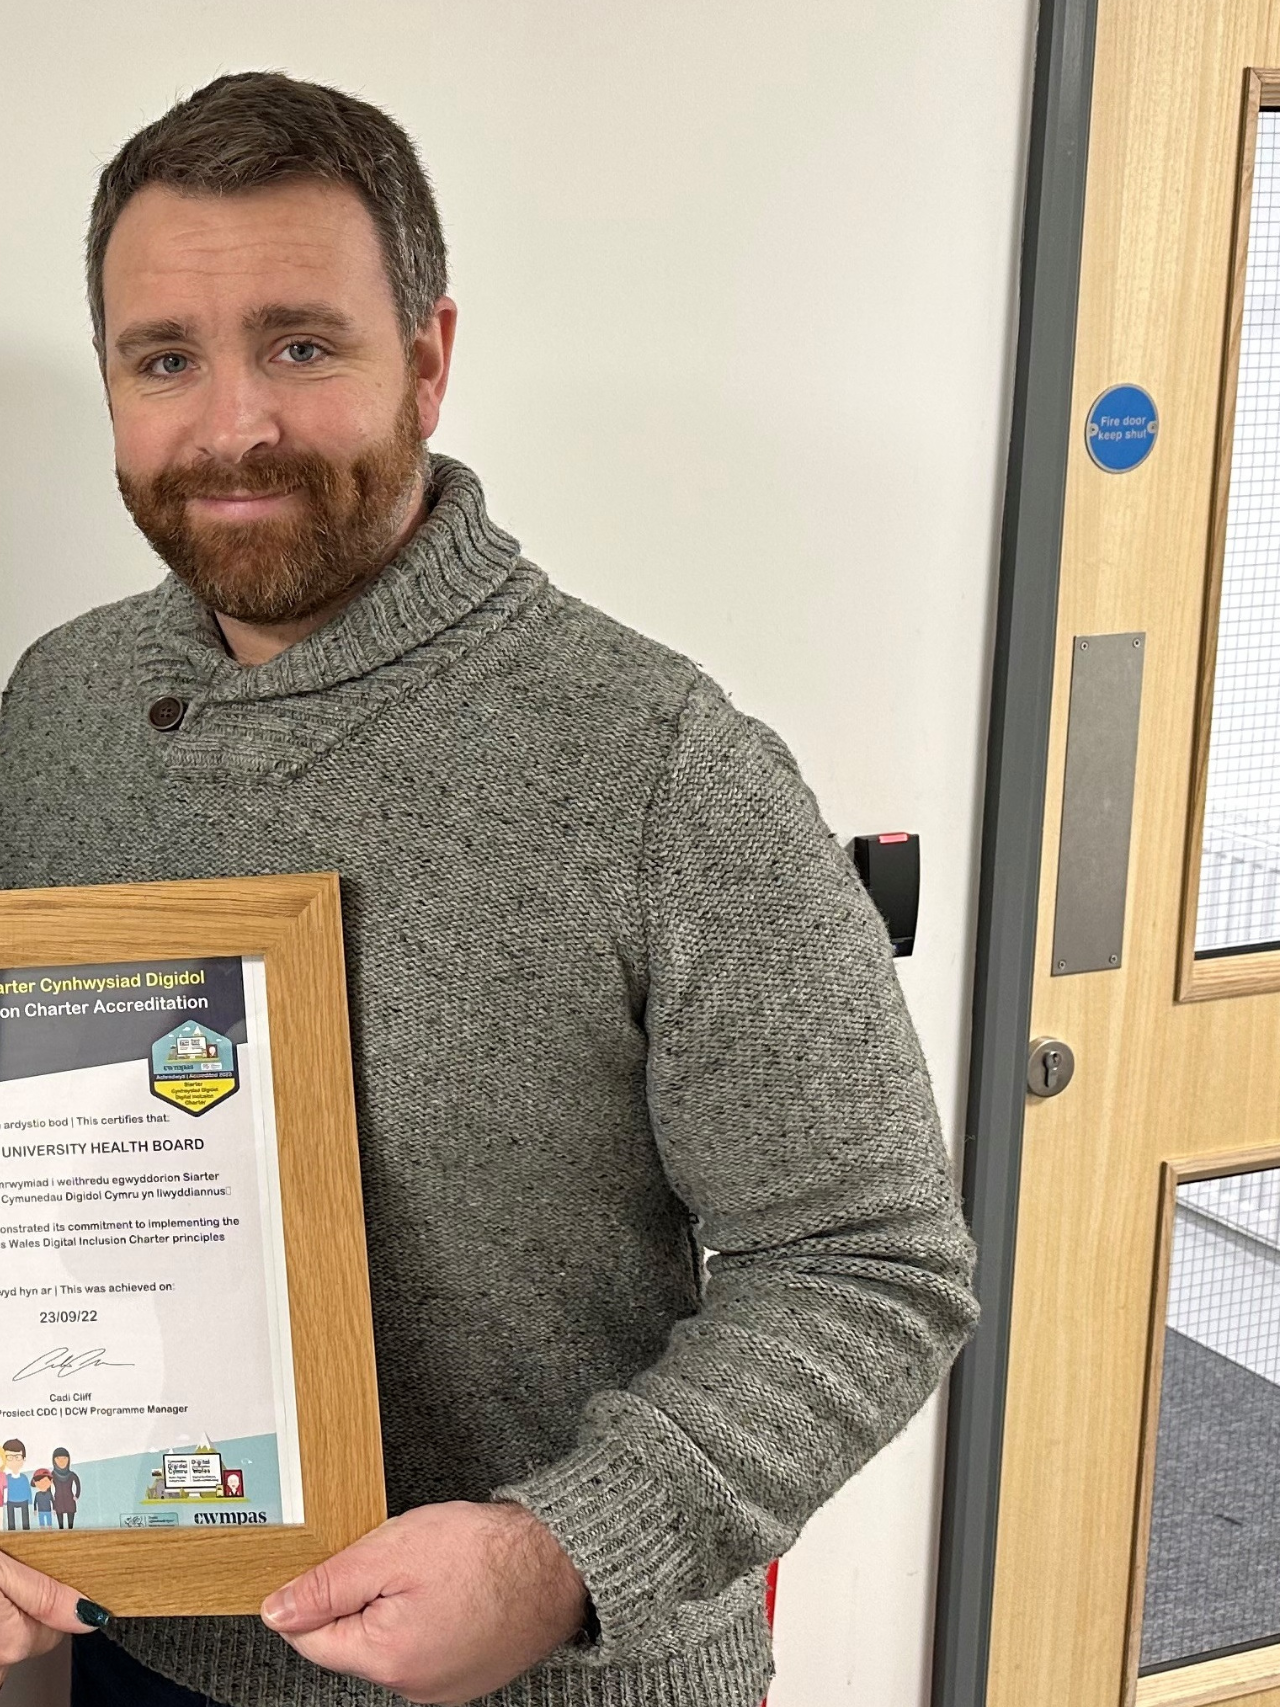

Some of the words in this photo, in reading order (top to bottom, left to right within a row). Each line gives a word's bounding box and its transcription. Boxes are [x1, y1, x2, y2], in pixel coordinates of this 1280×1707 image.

[1101, 416, 1120, 426] Fire
[1123, 416, 1146, 425] door
[1098, 431, 1122, 441] keep
[1125, 429, 1147, 438] shut
[40, 974, 141, 996] Cynhwysiad
[145, 970, 206, 988] Digidol
[24, 1000, 89, 1018] Charter
[93, 995, 208, 1015] Accreditation
[4, 1119, 46, 1131] ardystio
[48, 1117, 68, 1128] bod
[76, 1116, 98, 1126] This
[101, 1114, 143, 1126] certifies
[2, 1144, 87, 1155] UNIVERSITY
[91, 1141, 149, 1154] HEALTH
[153, 1138, 205, 1152] BOARD
[57, 1176, 109, 1187] weithredu
[112, 1173, 180, 1186] egwyddorion
[183, 1171, 219, 1182] Siarter
[1, 1193, 63, 1206] Cymunedau
[66, 1191, 102, 1203] Digidol
[105, 1189, 139, 1202] Cymru
[141, 1190, 154, 1200] yn
[53, 1222, 65, 1232] its
[68, 1220, 133, 1231] commitment
[136, 1220, 146, 1229] to
[148, 1217, 220, 1230] implementing
[223, 1216, 240, 1226] the
[9, 1238, 41, 1249] Wales
[43, 1237, 76, 1248] Digital
[79, 1235, 127, 1246] Inclusion
[129, 1233, 169, 1244] Charter
[172, 1232, 225, 1244] principles
[19, 1286, 38, 1297] hyn
[41, 1287, 52, 1295] ar
[60, 1284, 82, 1294] This
[84, 1285, 106, 1293] was
[109, 1282, 156, 1293] achieved
[39, 1310, 98, 1324] 23/09/22
[50, 1393, 71, 1402] Cadi
[74, 1392, 92, 1402] Cliff
[36, 1407, 57, 1417] CDC
[65, 1406, 88, 1416] DCW
[90, 1405, 145, 1417] Programme
[148, 1404, 188, 1416] Manager
[194, 1511, 267, 1525] cwmpas
